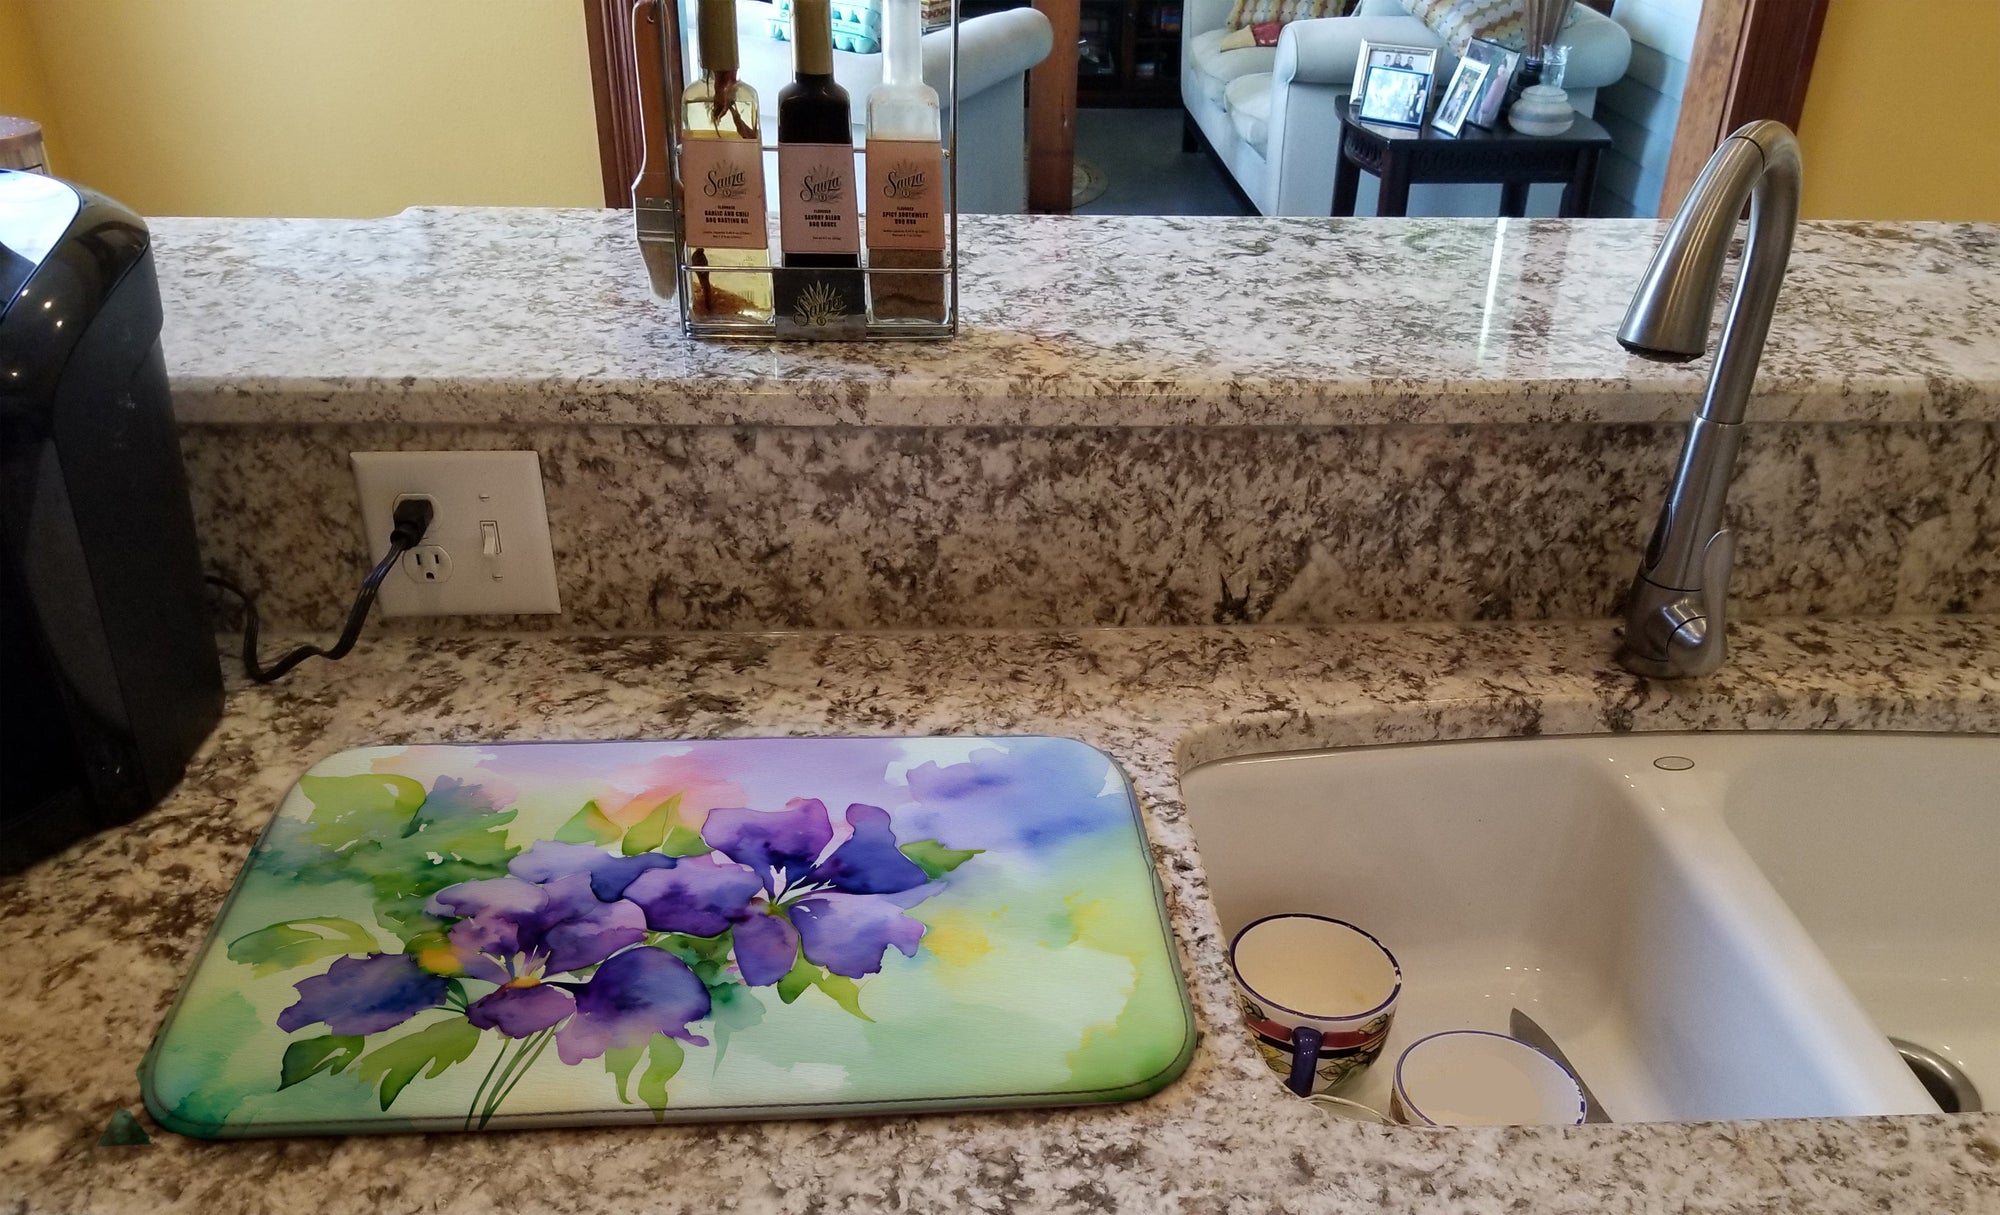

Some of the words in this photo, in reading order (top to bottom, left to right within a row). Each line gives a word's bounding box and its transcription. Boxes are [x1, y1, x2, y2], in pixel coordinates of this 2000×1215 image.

[704, 170, 745, 197] Sauza
[800, 175, 841, 202] Sauza
[884, 171, 925, 198] Sauza
